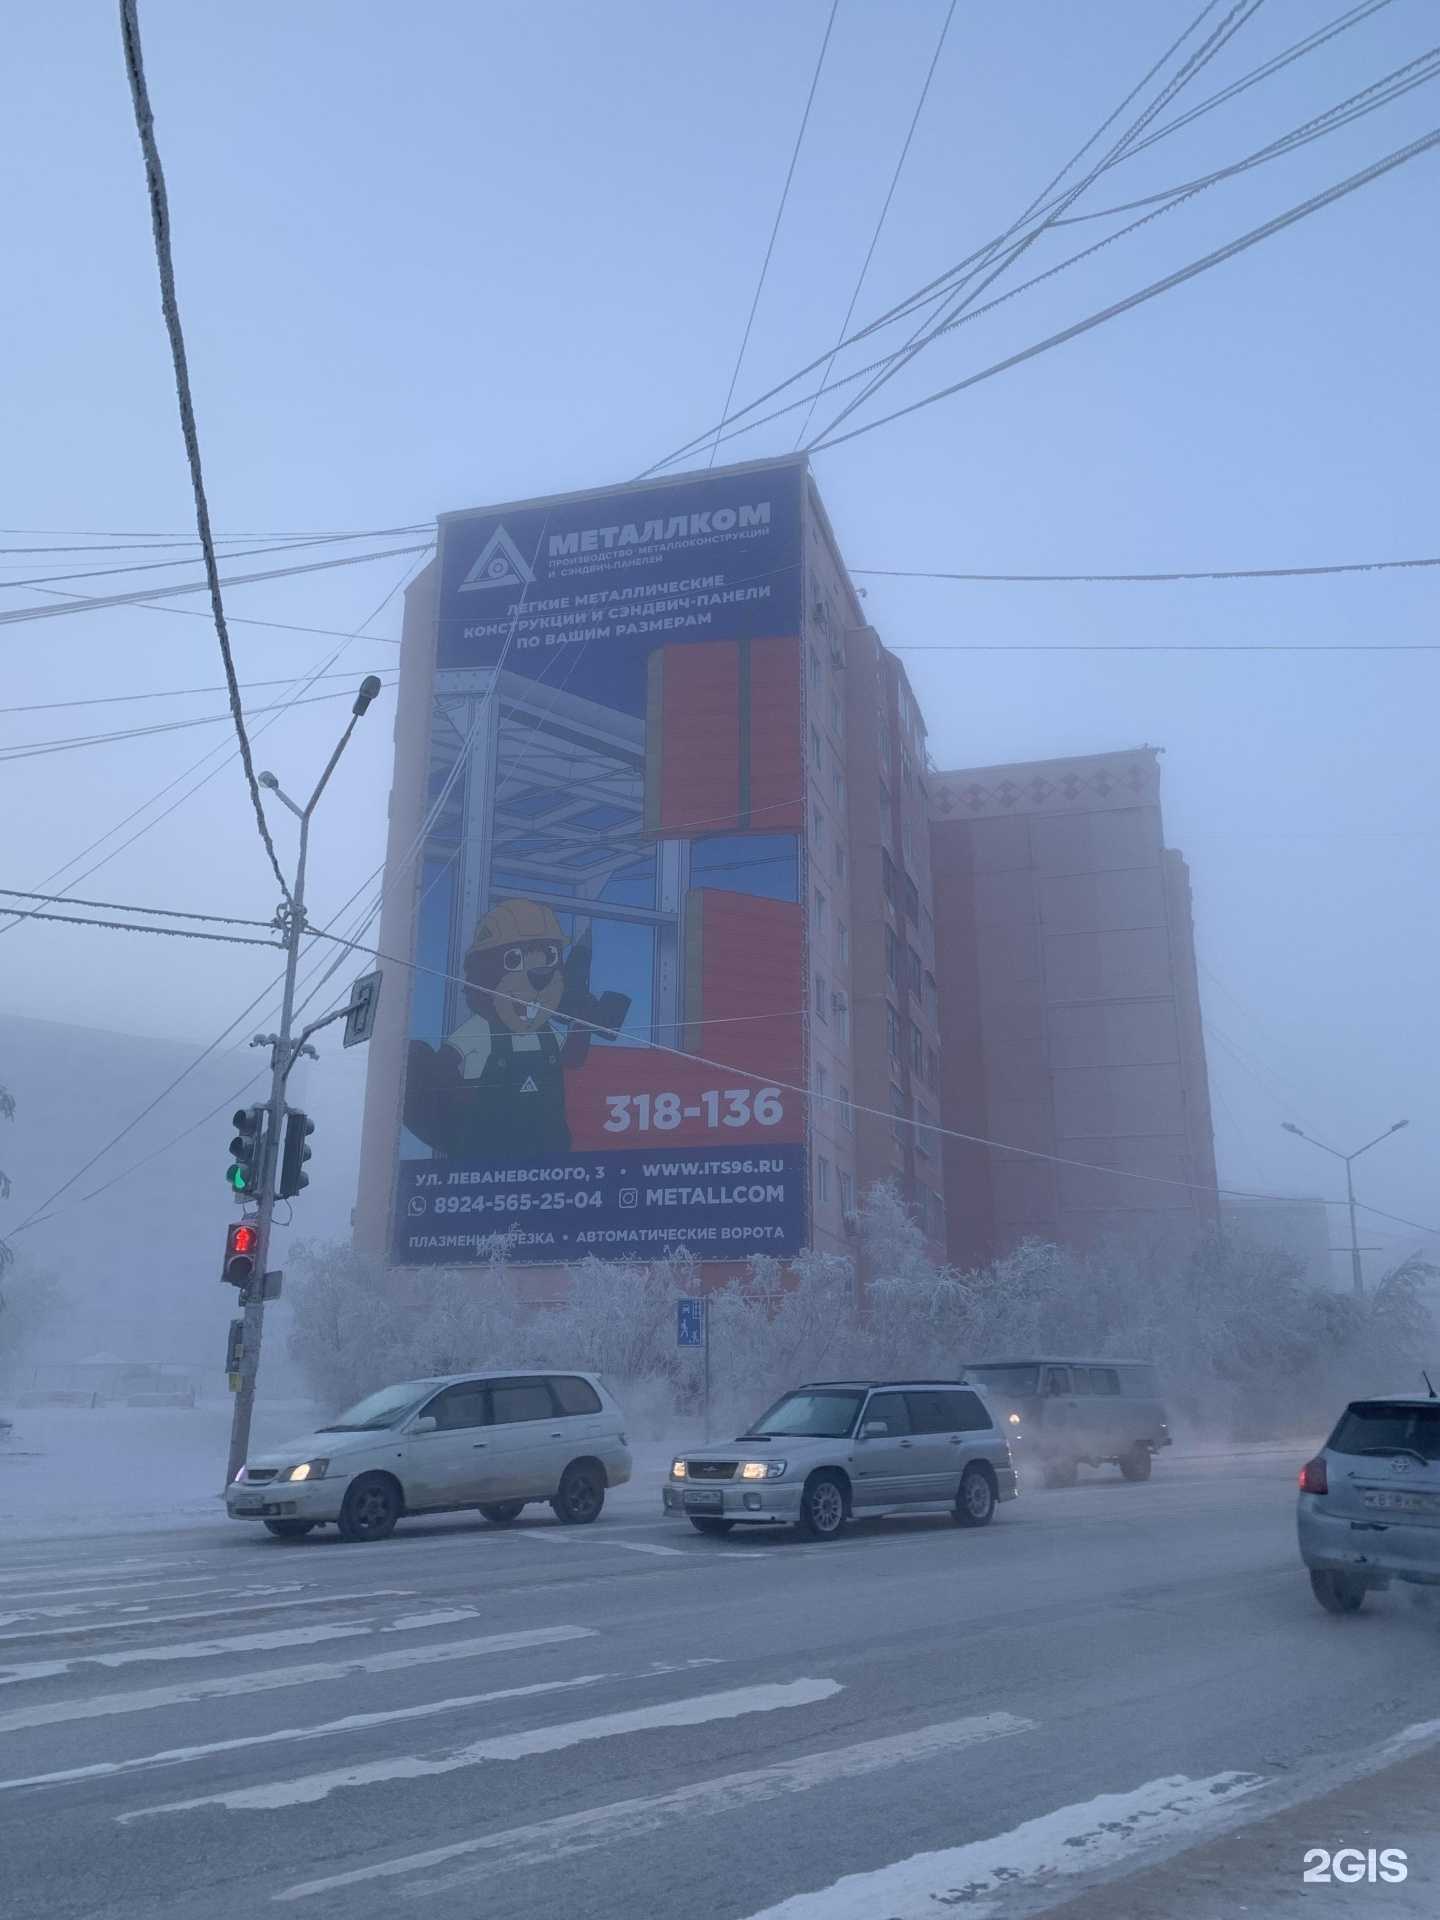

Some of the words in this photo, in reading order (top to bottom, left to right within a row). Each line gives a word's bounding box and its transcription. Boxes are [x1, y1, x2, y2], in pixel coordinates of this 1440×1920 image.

[549, 502, 771, 557] МЕТАЛЛКОМ
[506, 597, 570, 616] ЛЕГКИЕ
[575, 574, 725, 607] МЕТАЛЛИЧЕСКИЕ
[607, 585, 772, 619] СЭНДВИЧ-ПАНЕЛИ
[516, 636, 541, 649] ПО
[544, 626, 611, 646] ВАШИМ
[615, 612, 713, 636] РАЗМЕРАМ
[603, 1087, 784, 1133] 318-136
[415, 1173, 443, 1187] УЛ.
[446, 1166, 591, 1185] ЛЕВАНЕВСКОГО,
[594, 1165, 606, 1180] 3
[642, 1159, 785, 1178] WWW.ITS96.RU
[434, 1191, 604, 1215] 8924-565-25-04
[645, 1184, 786, 1207] METALLCOM
[575, 1227, 718, 1244] АВТОМАТИЧЕСКИЕ
[720, 1225, 786, 1240] ВОРОТА
